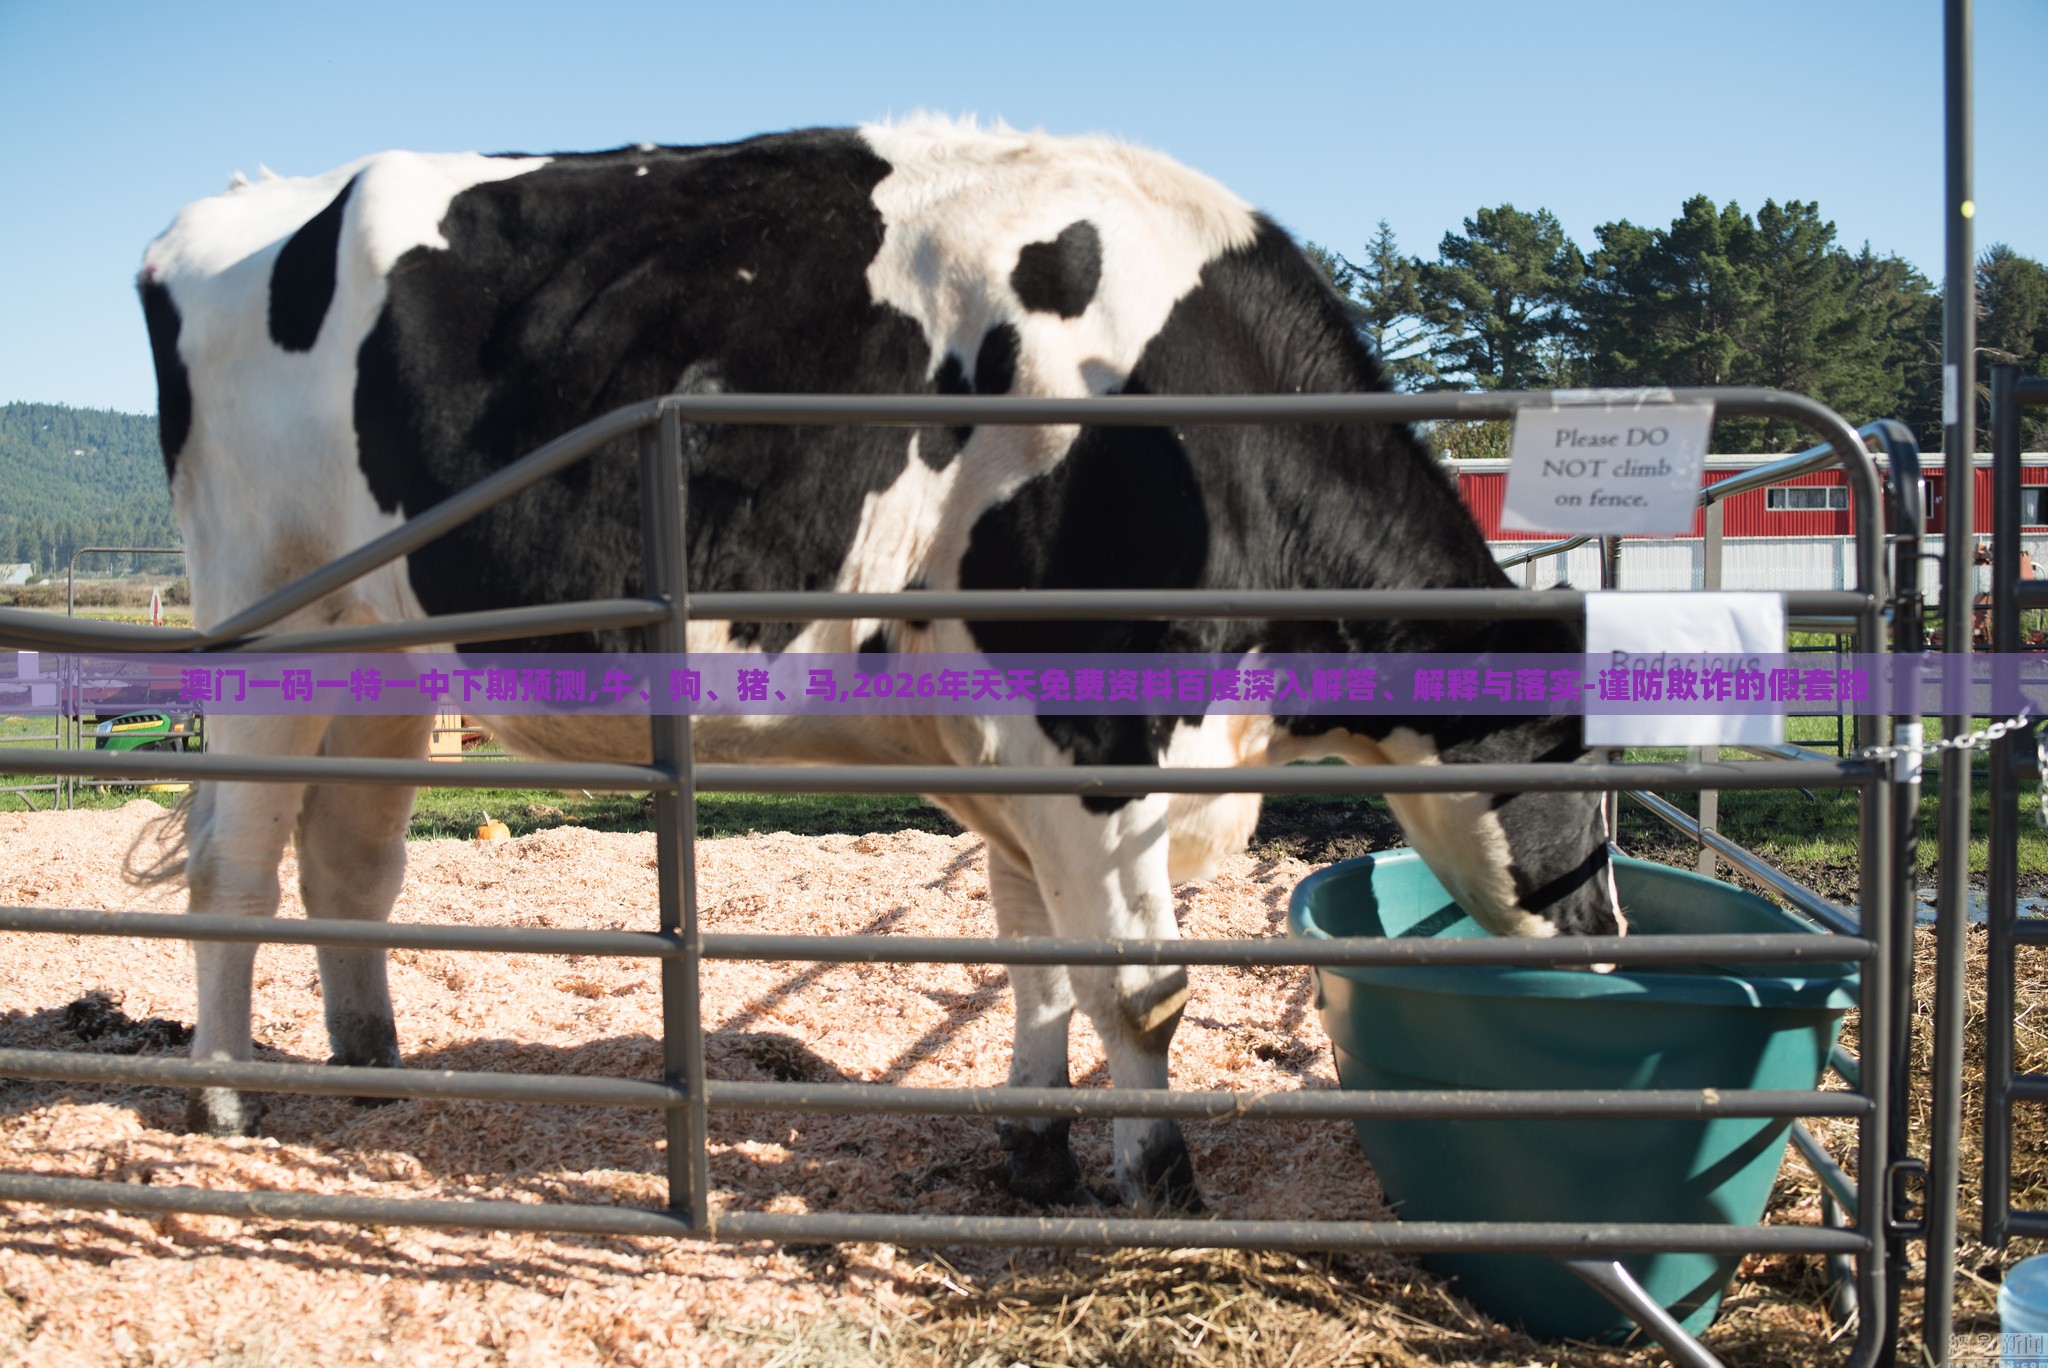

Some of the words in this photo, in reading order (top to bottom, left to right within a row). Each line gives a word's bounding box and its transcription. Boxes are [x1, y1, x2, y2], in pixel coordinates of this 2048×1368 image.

[1555, 427, 1620, 447] Please
[1626, 426, 1670, 447] DO
[1542, 458, 1608, 478] NOT
[1612, 457, 1673, 477] climb
[1554, 494, 1582, 507] on
[1590, 487, 1649, 507] fence.
